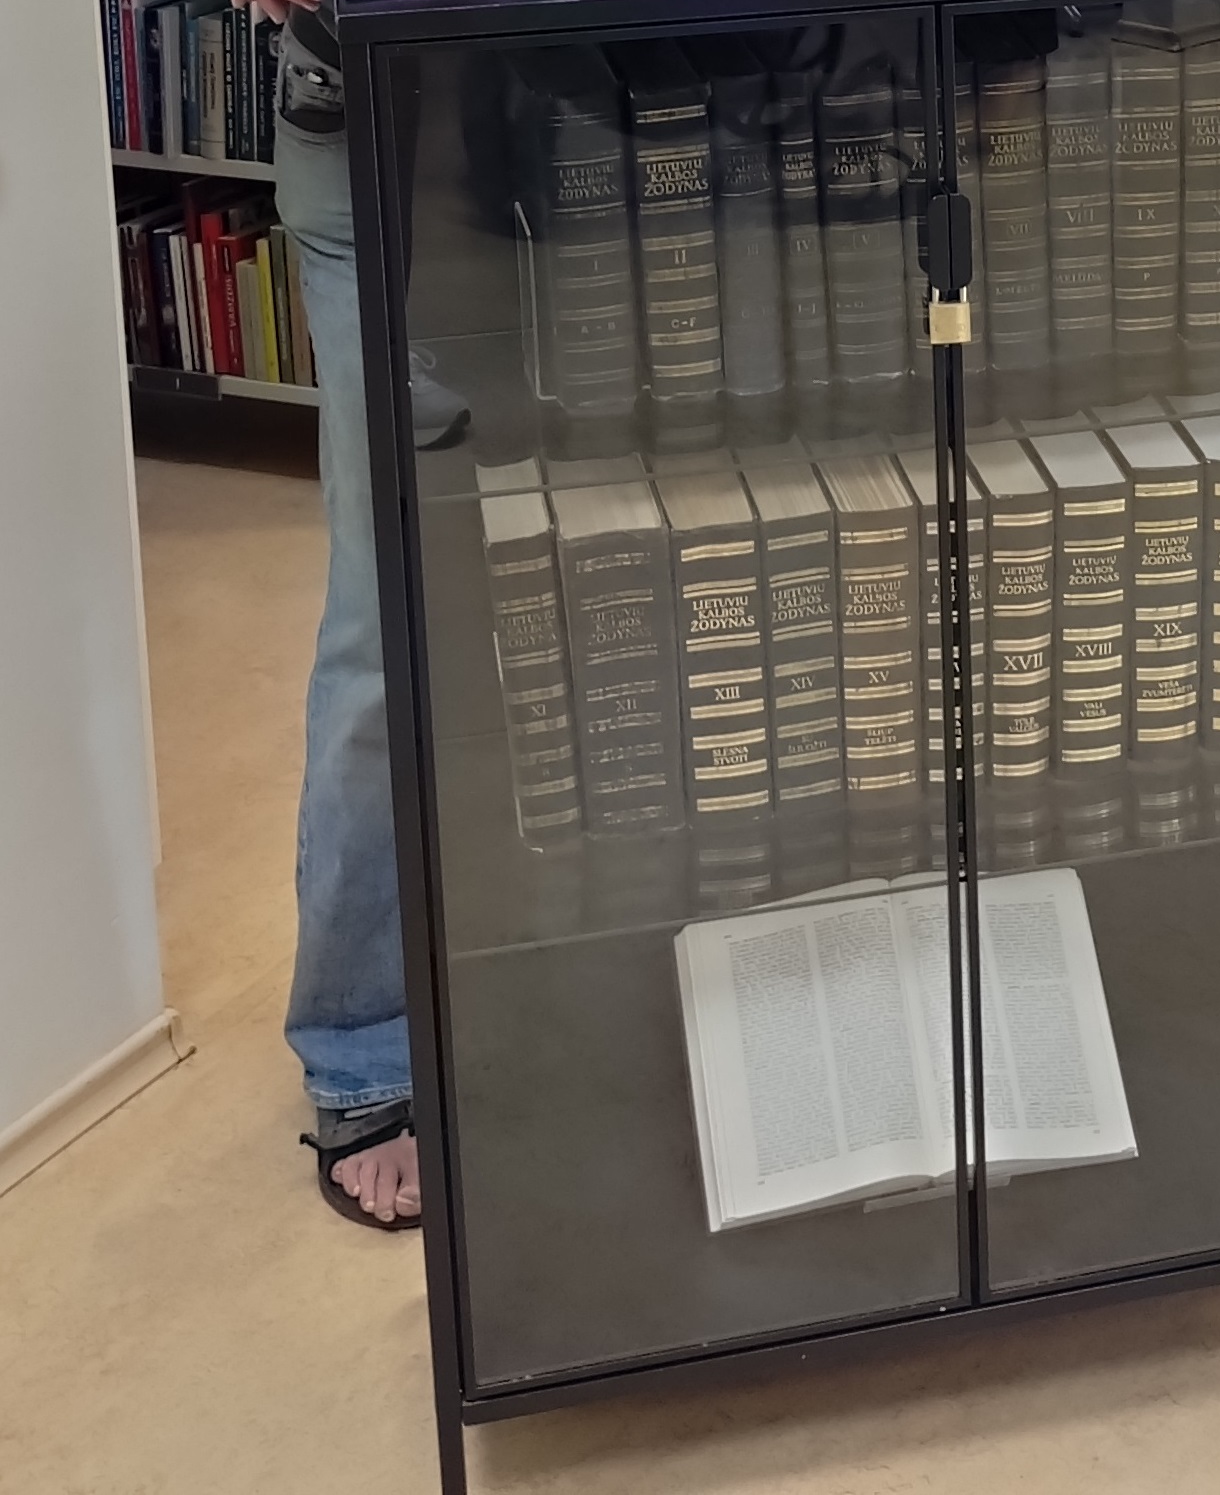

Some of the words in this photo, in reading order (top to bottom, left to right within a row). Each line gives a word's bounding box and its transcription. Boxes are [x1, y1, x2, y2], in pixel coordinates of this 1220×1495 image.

[651, 170, 698, 183] KALBOS
[644, 178, 709, 197] ŽODYNAS
[674, 249, 687, 264] II
[1149, 545, 1187, 555] KALBOS
[1142, 552, 1193, 566] ŽODYNAS
[1075, 565, 1114, 574] KALBOS
[1005, 575, 1043, 584] KALBOS
[1069, 573, 1120, 586] ŽODYNAS
[999, 582, 1049, 595] ŽODYNAS
[777, 595, 822, 610] KALBOS
[853, 592, 898, 604] KALBOS
[698, 607, 745, 619] KALBOS
[771, 604, 831, 623] ŽODYNAS
[845, 601, 906, 616] ŽODYNAS
[690, 615, 755, 633] ŽODYNAS
[1153, 622, 1183, 637] XIX
[1075, 642, 1112, 657] XVIII
[1003, 652, 1043, 670] XVII
[790, 676, 816, 691] XIV
[868, 671, 890, 684] XV
[714, 686, 740, 700] XIII
